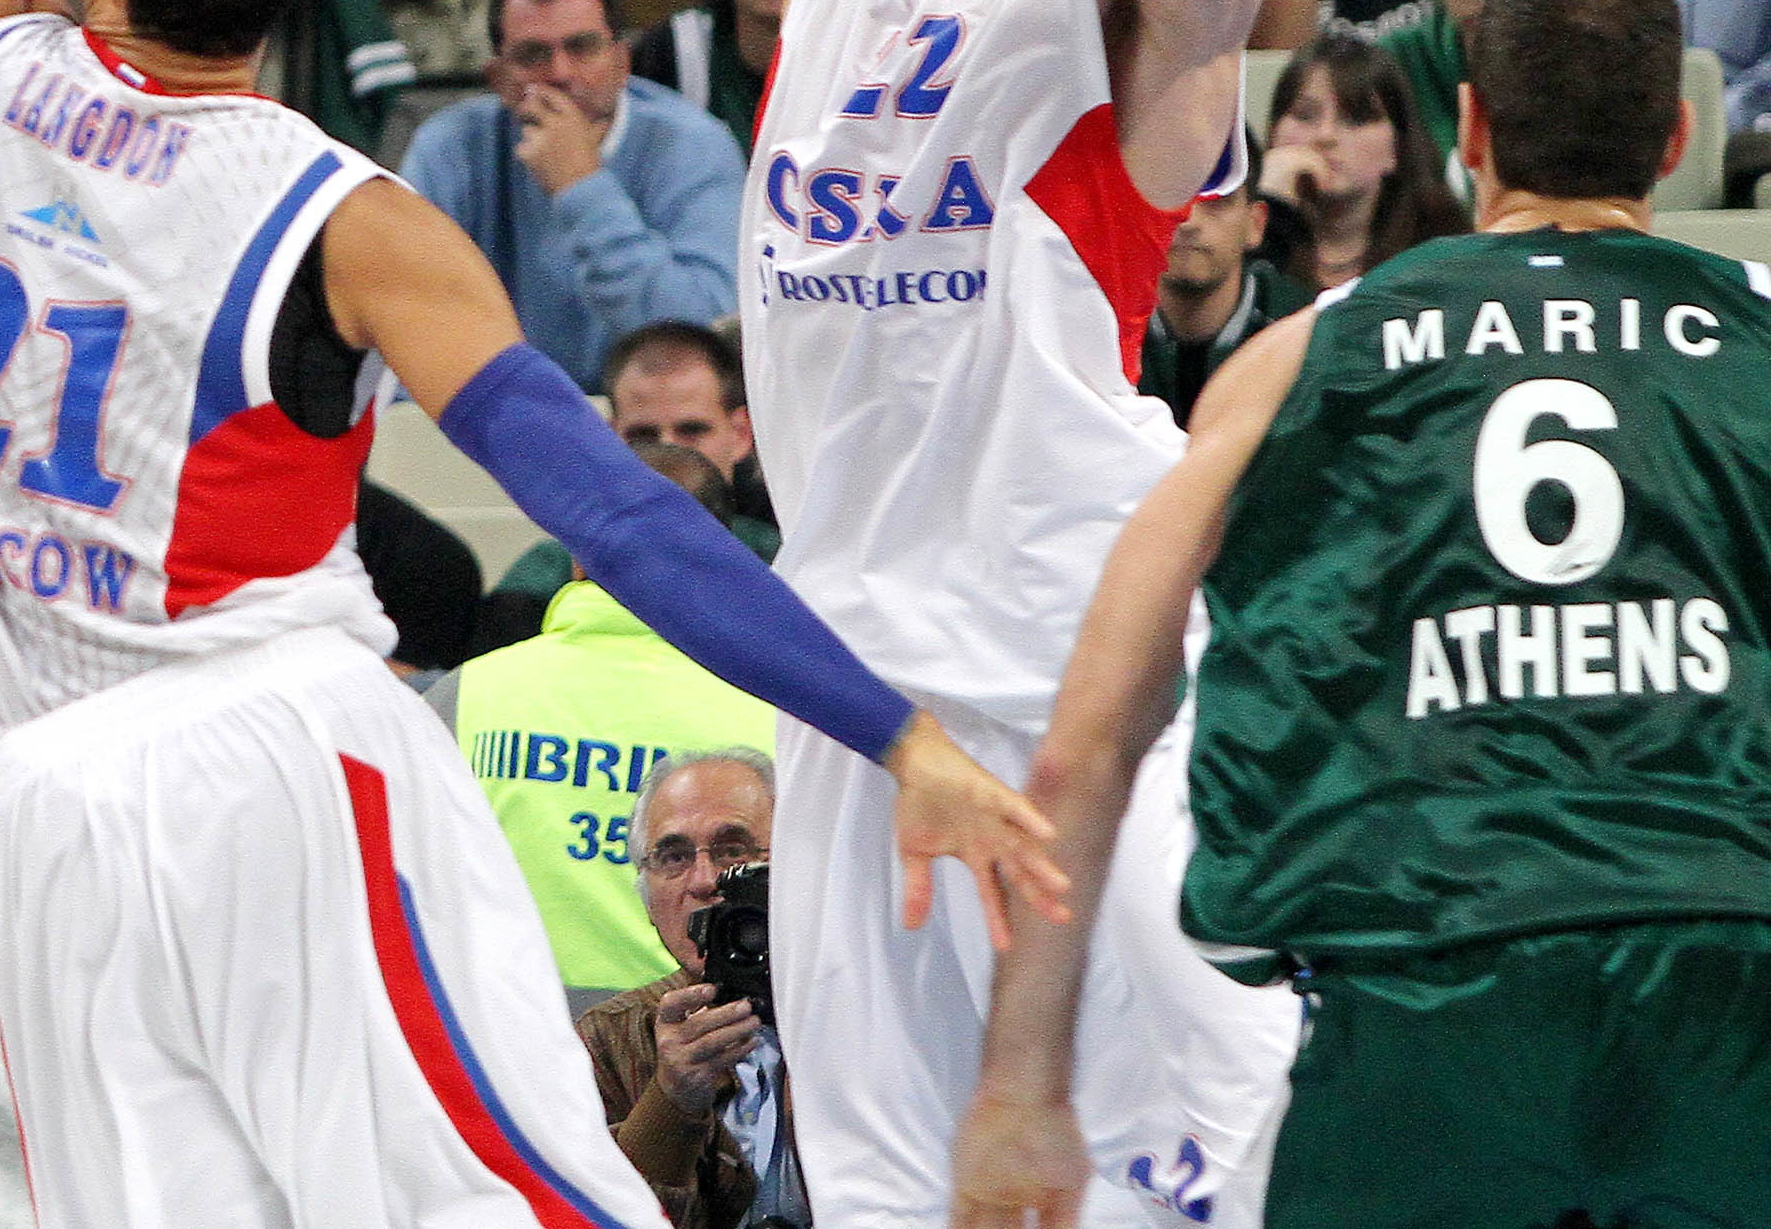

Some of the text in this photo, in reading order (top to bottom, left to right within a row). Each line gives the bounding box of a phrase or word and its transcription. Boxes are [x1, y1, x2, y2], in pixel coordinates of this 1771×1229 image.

[3, 61, 196, 189] LANGDON
[777, 269, 988, 311] ROSTELECO
[1381, 297, 1722, 370] MARIC
[1472, 377, 1626, 586] 6
[1405, 597, 1730, 719] ATHENS
[567, 811, 632, 865] 35
